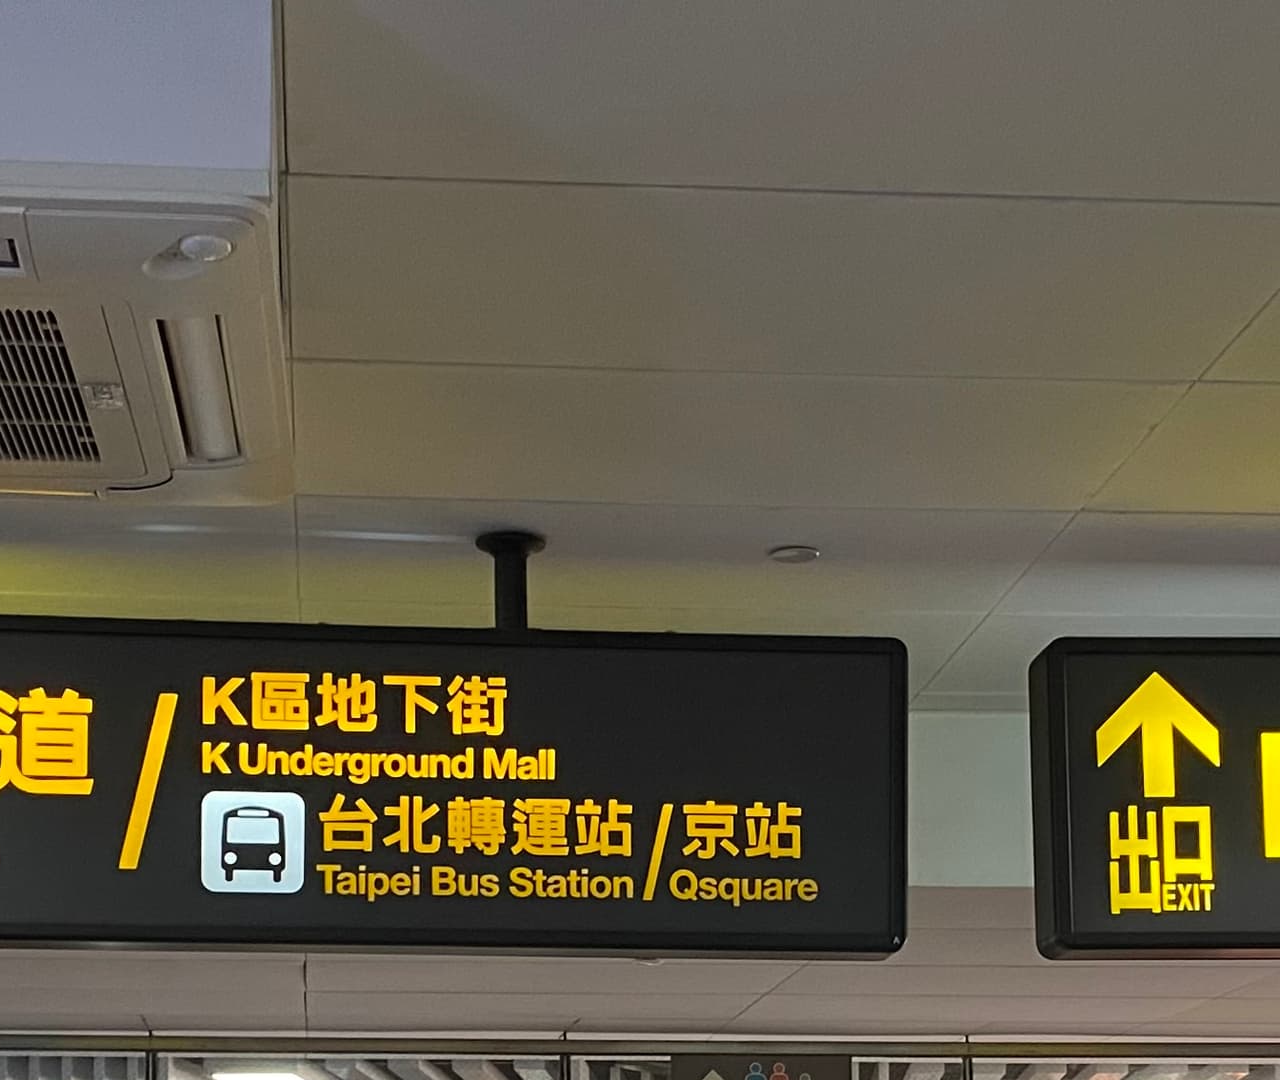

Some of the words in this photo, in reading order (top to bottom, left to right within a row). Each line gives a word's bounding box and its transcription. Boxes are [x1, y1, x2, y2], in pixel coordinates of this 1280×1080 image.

[201, 671, 508, 736] K區地下街
[201, 743, 231, 775] K
[238, 744, 475, 784] Underground
[482, 749, 557, 782] Mall
[316, 793, 633, 859] 台北轉運站
[682, 802, 804, 860] 京站
[317, 864, 421, 904] Taipei
[431, 869, 503, 899] Bus
[509, 869, 634, 901] Station
[668, 870, 819, 907] Qsquare
[1110, 804, 1212, 914] 出口
[1162, 883, 1216, 912] EXIT
